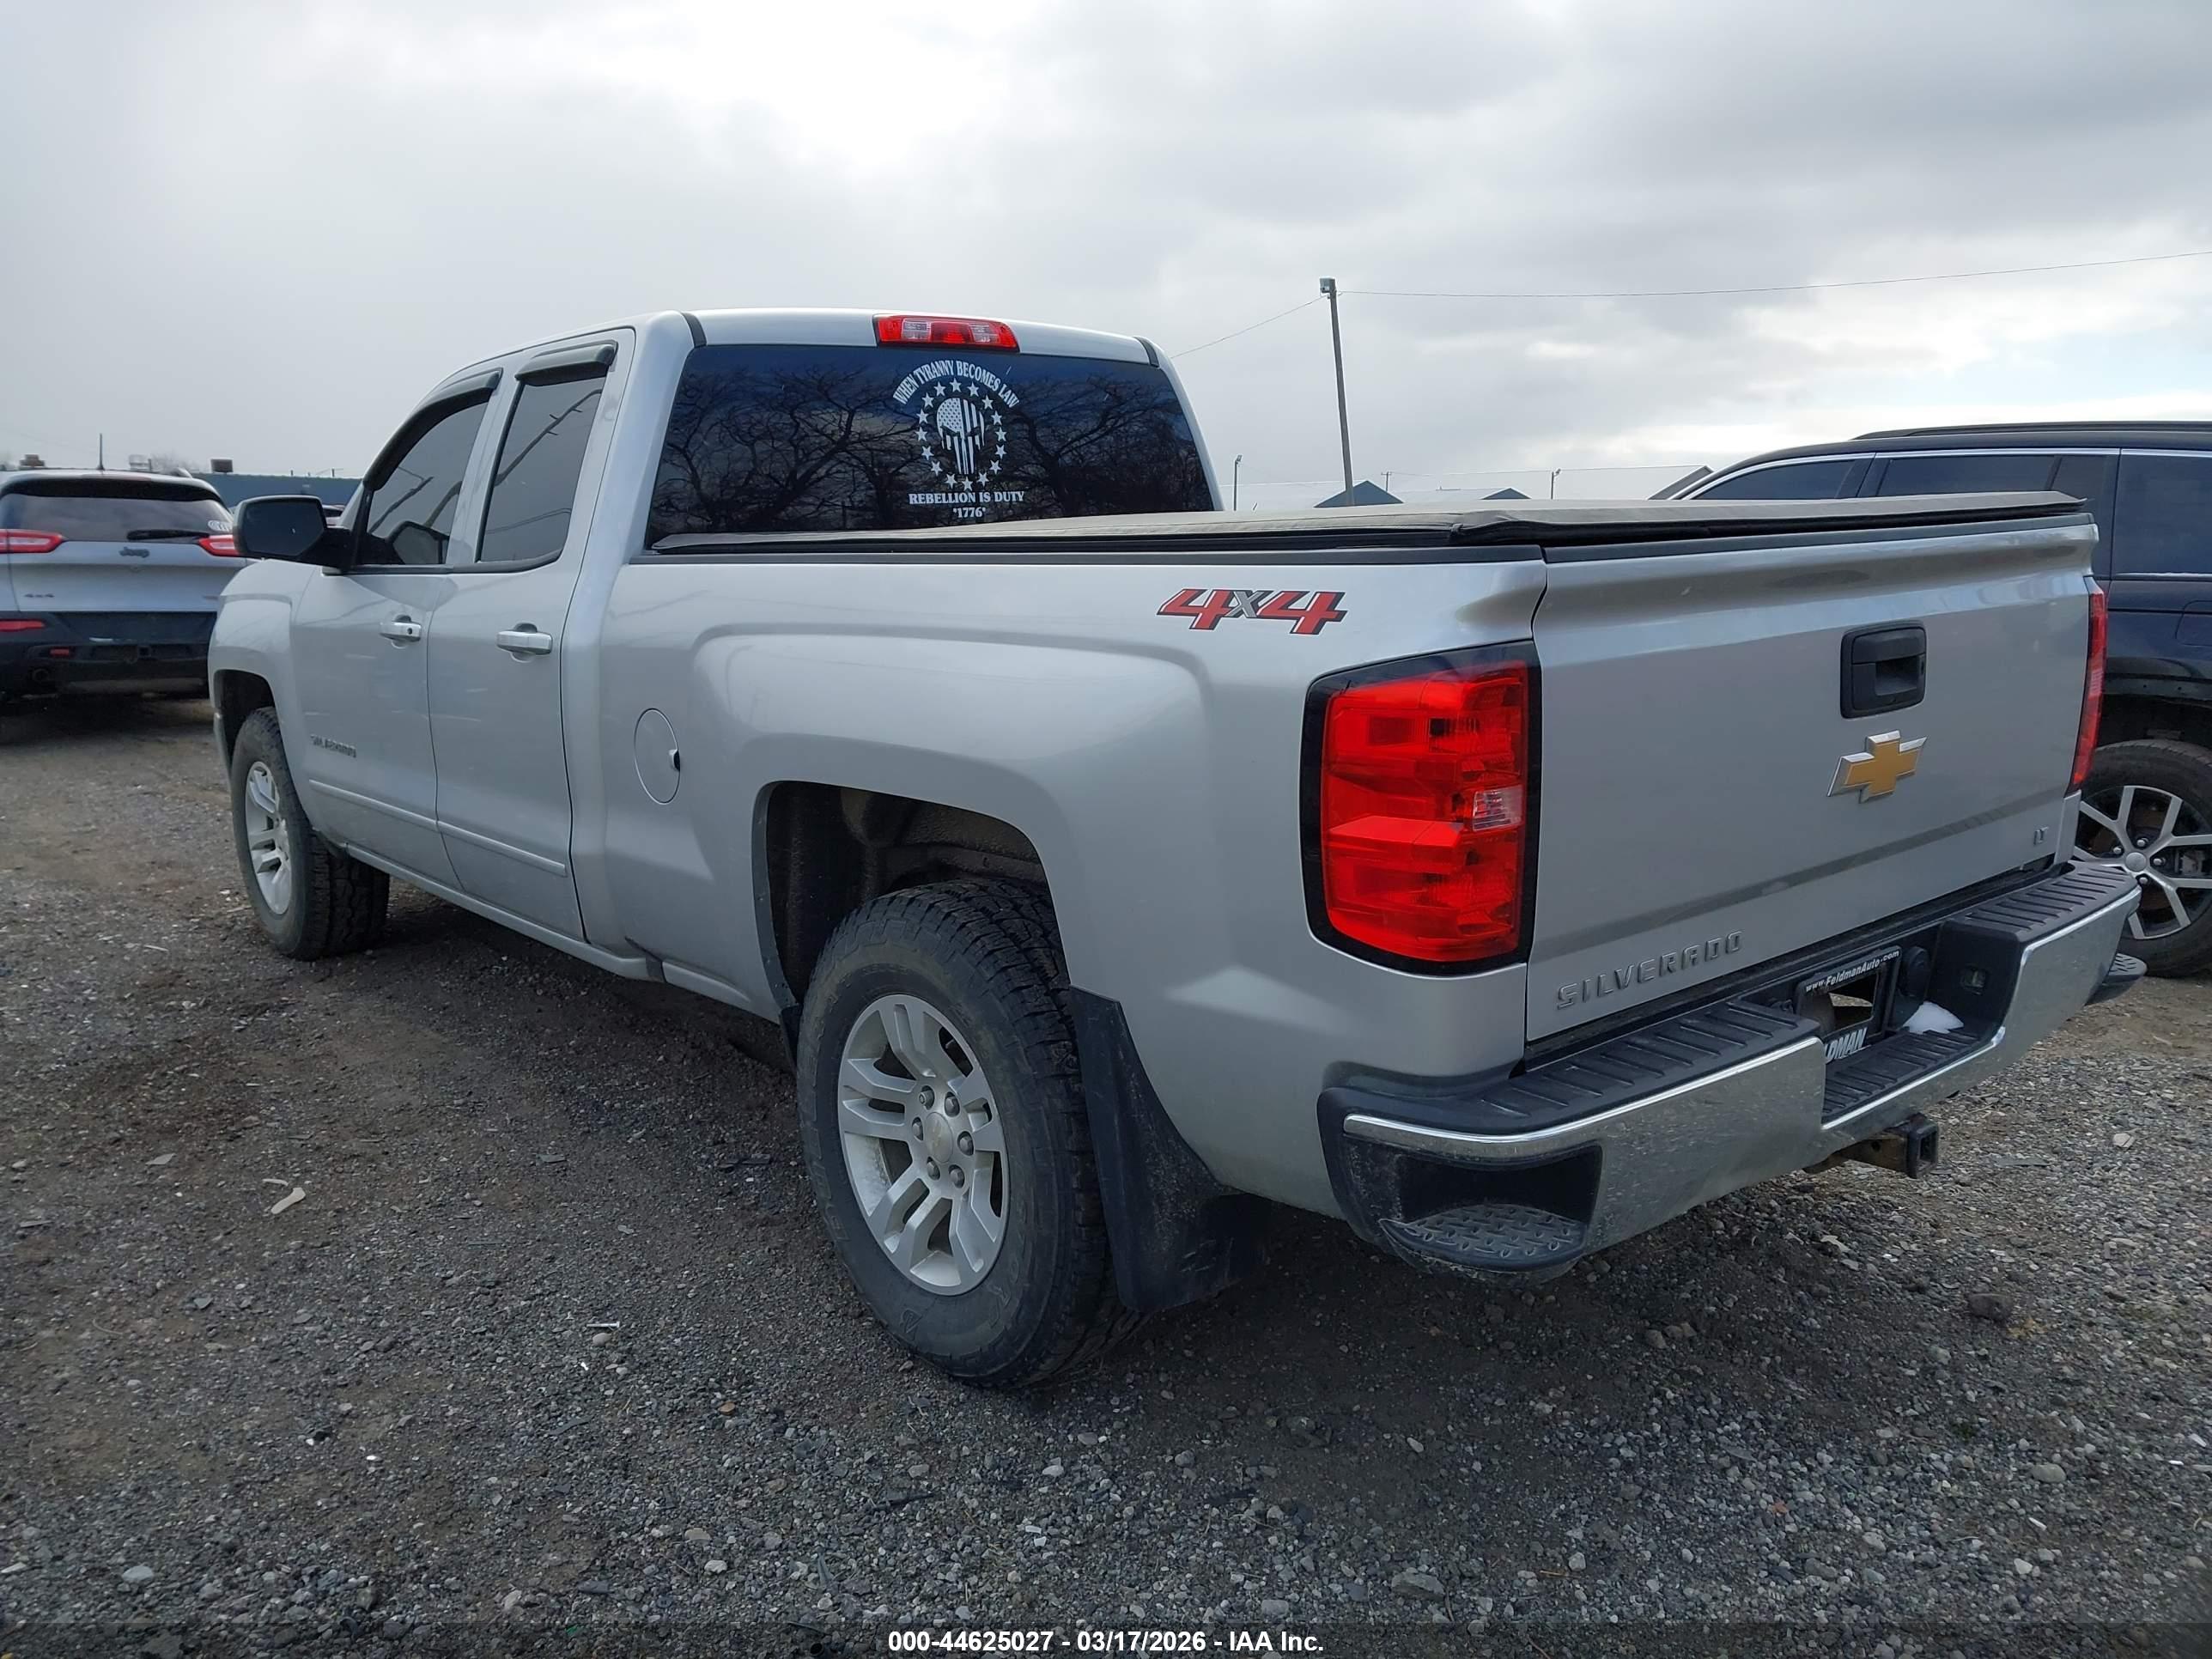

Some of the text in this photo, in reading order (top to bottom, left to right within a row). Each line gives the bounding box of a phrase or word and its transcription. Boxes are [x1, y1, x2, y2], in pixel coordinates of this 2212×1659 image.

[893, 359, 1020, 409] WHEN TYRANNY BECOMES LAW
[908, 490, 1024, 504] REBELLION IS DUTY
[1557, 929, 1745, 1010] SILVERADO
[1806, 950, 1899, 992] www.FeldmanAuto.com
